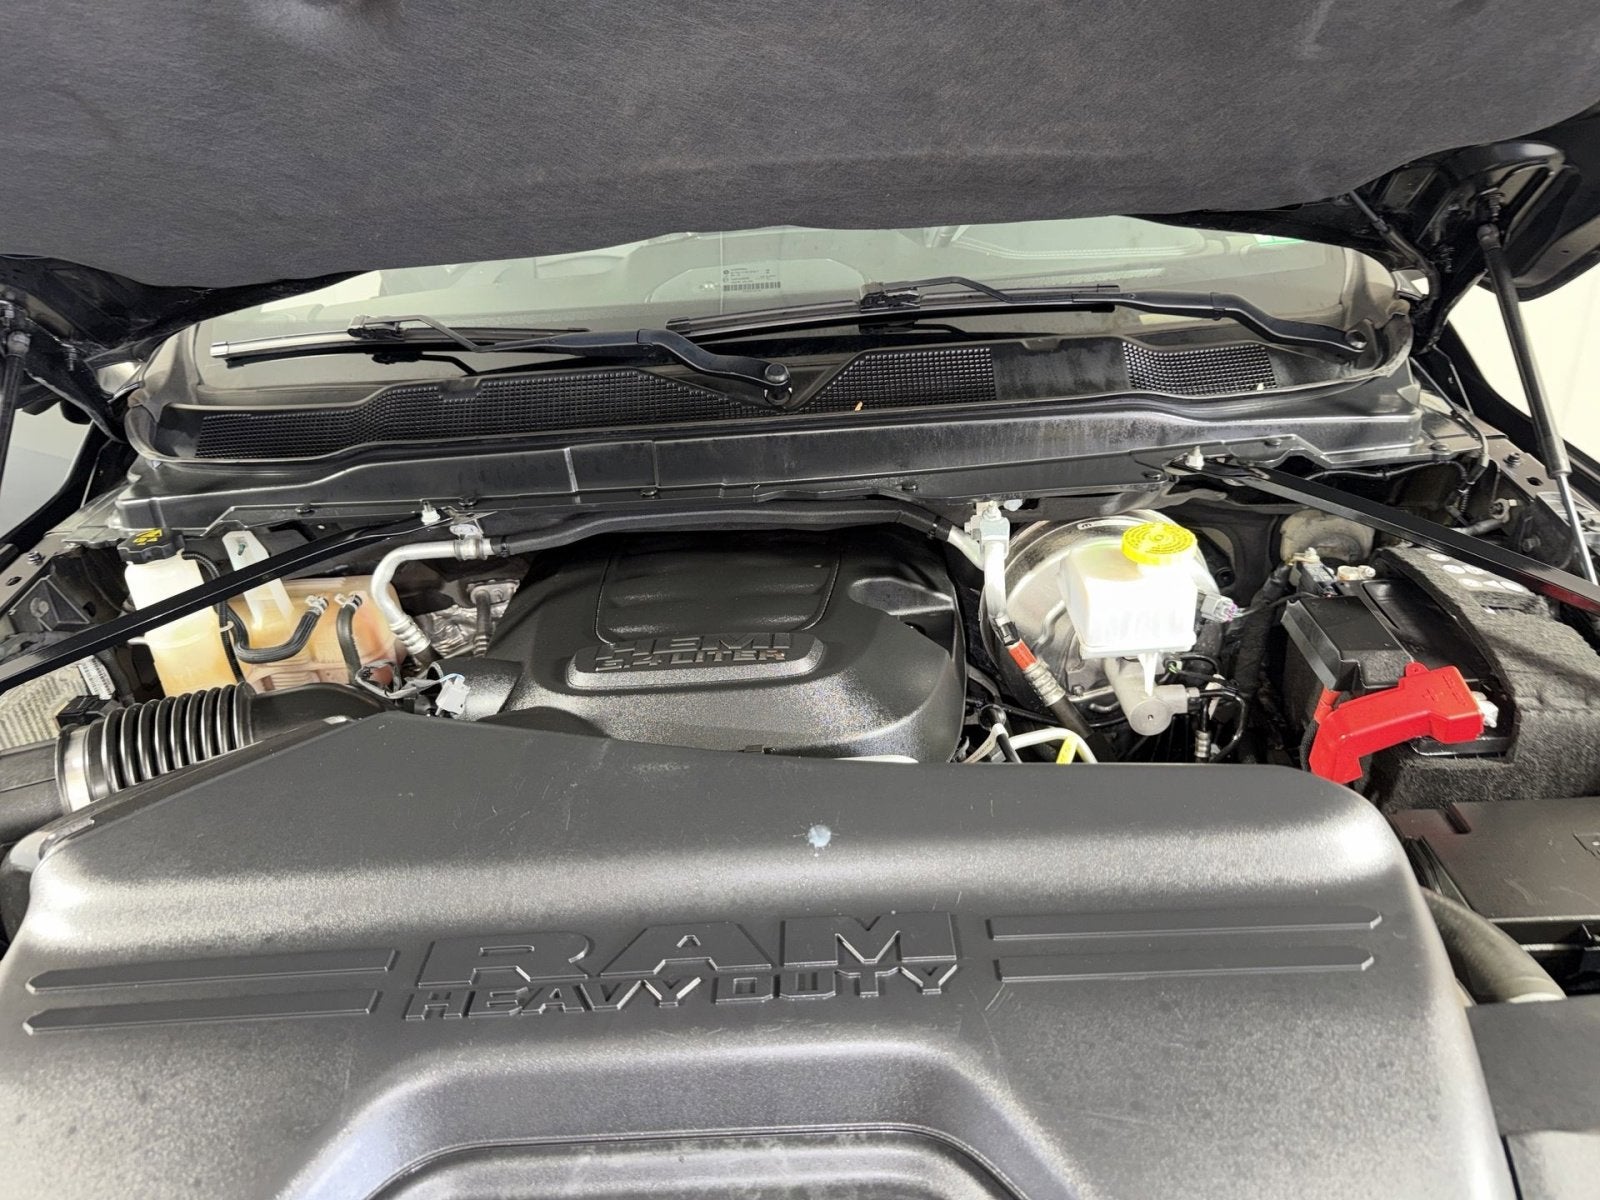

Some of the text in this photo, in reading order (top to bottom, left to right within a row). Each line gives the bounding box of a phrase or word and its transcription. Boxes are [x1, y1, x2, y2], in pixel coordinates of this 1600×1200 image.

[596, 632, 790, 660] HEMI
[669, 649, 786, 665] LITER
[417, 911, 958, 988] RAM
[404, 965, 958, 1021] HEAVY DUTY
